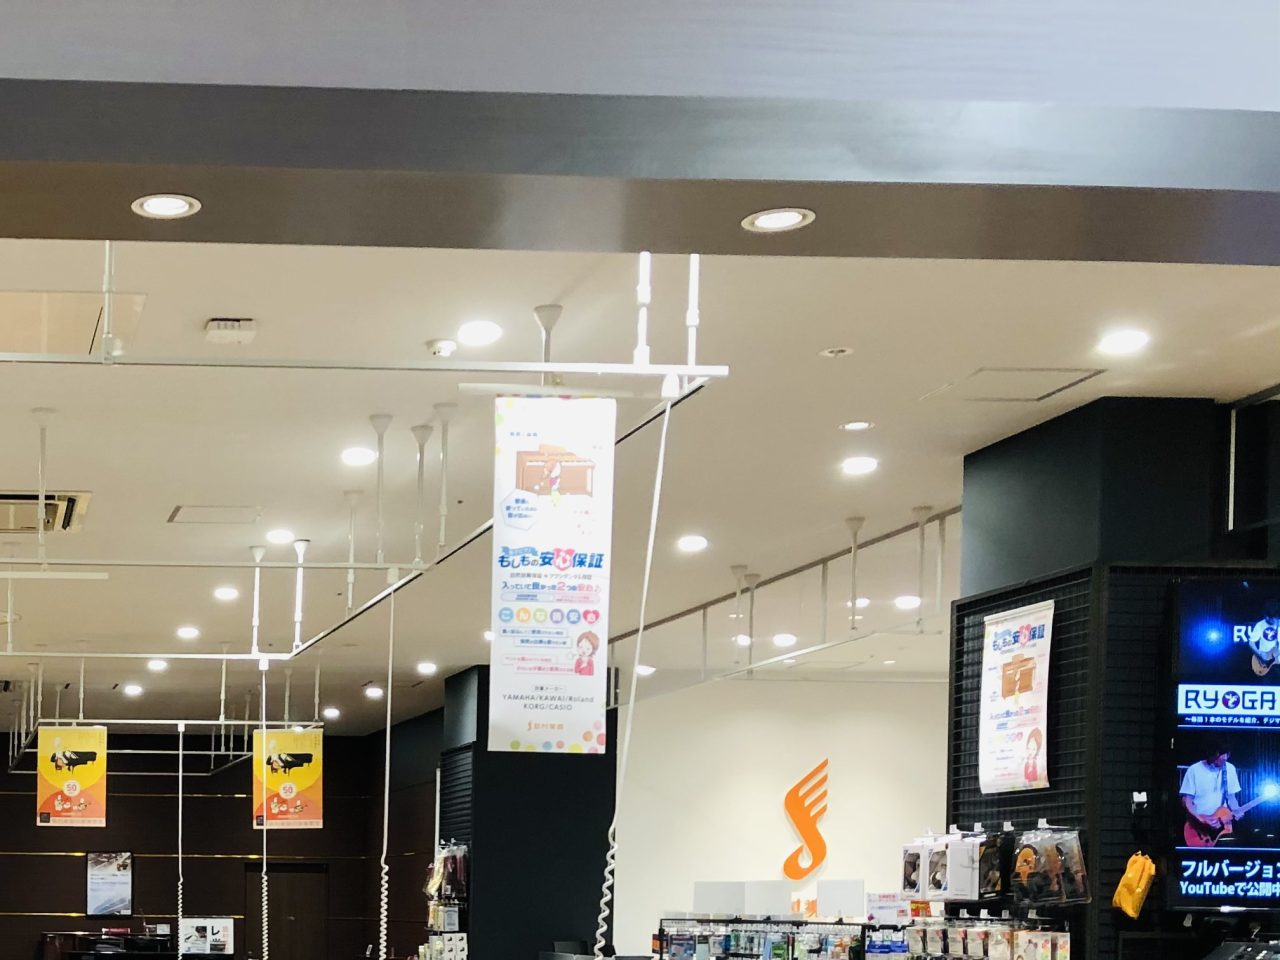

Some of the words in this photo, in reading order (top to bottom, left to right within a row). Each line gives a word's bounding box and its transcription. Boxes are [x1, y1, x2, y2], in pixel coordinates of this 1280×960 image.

[498, 551, 604, 568] もしもの安心保証
[502, 694, 595, 703] YAMAHA/KAWAI/Roland
[523, 703, 573, 711] KORG/CASIO
[1181, 859, 1280, 879] フルバージョ
[1180, 881, 1280, 897] YouTubeで公開中
